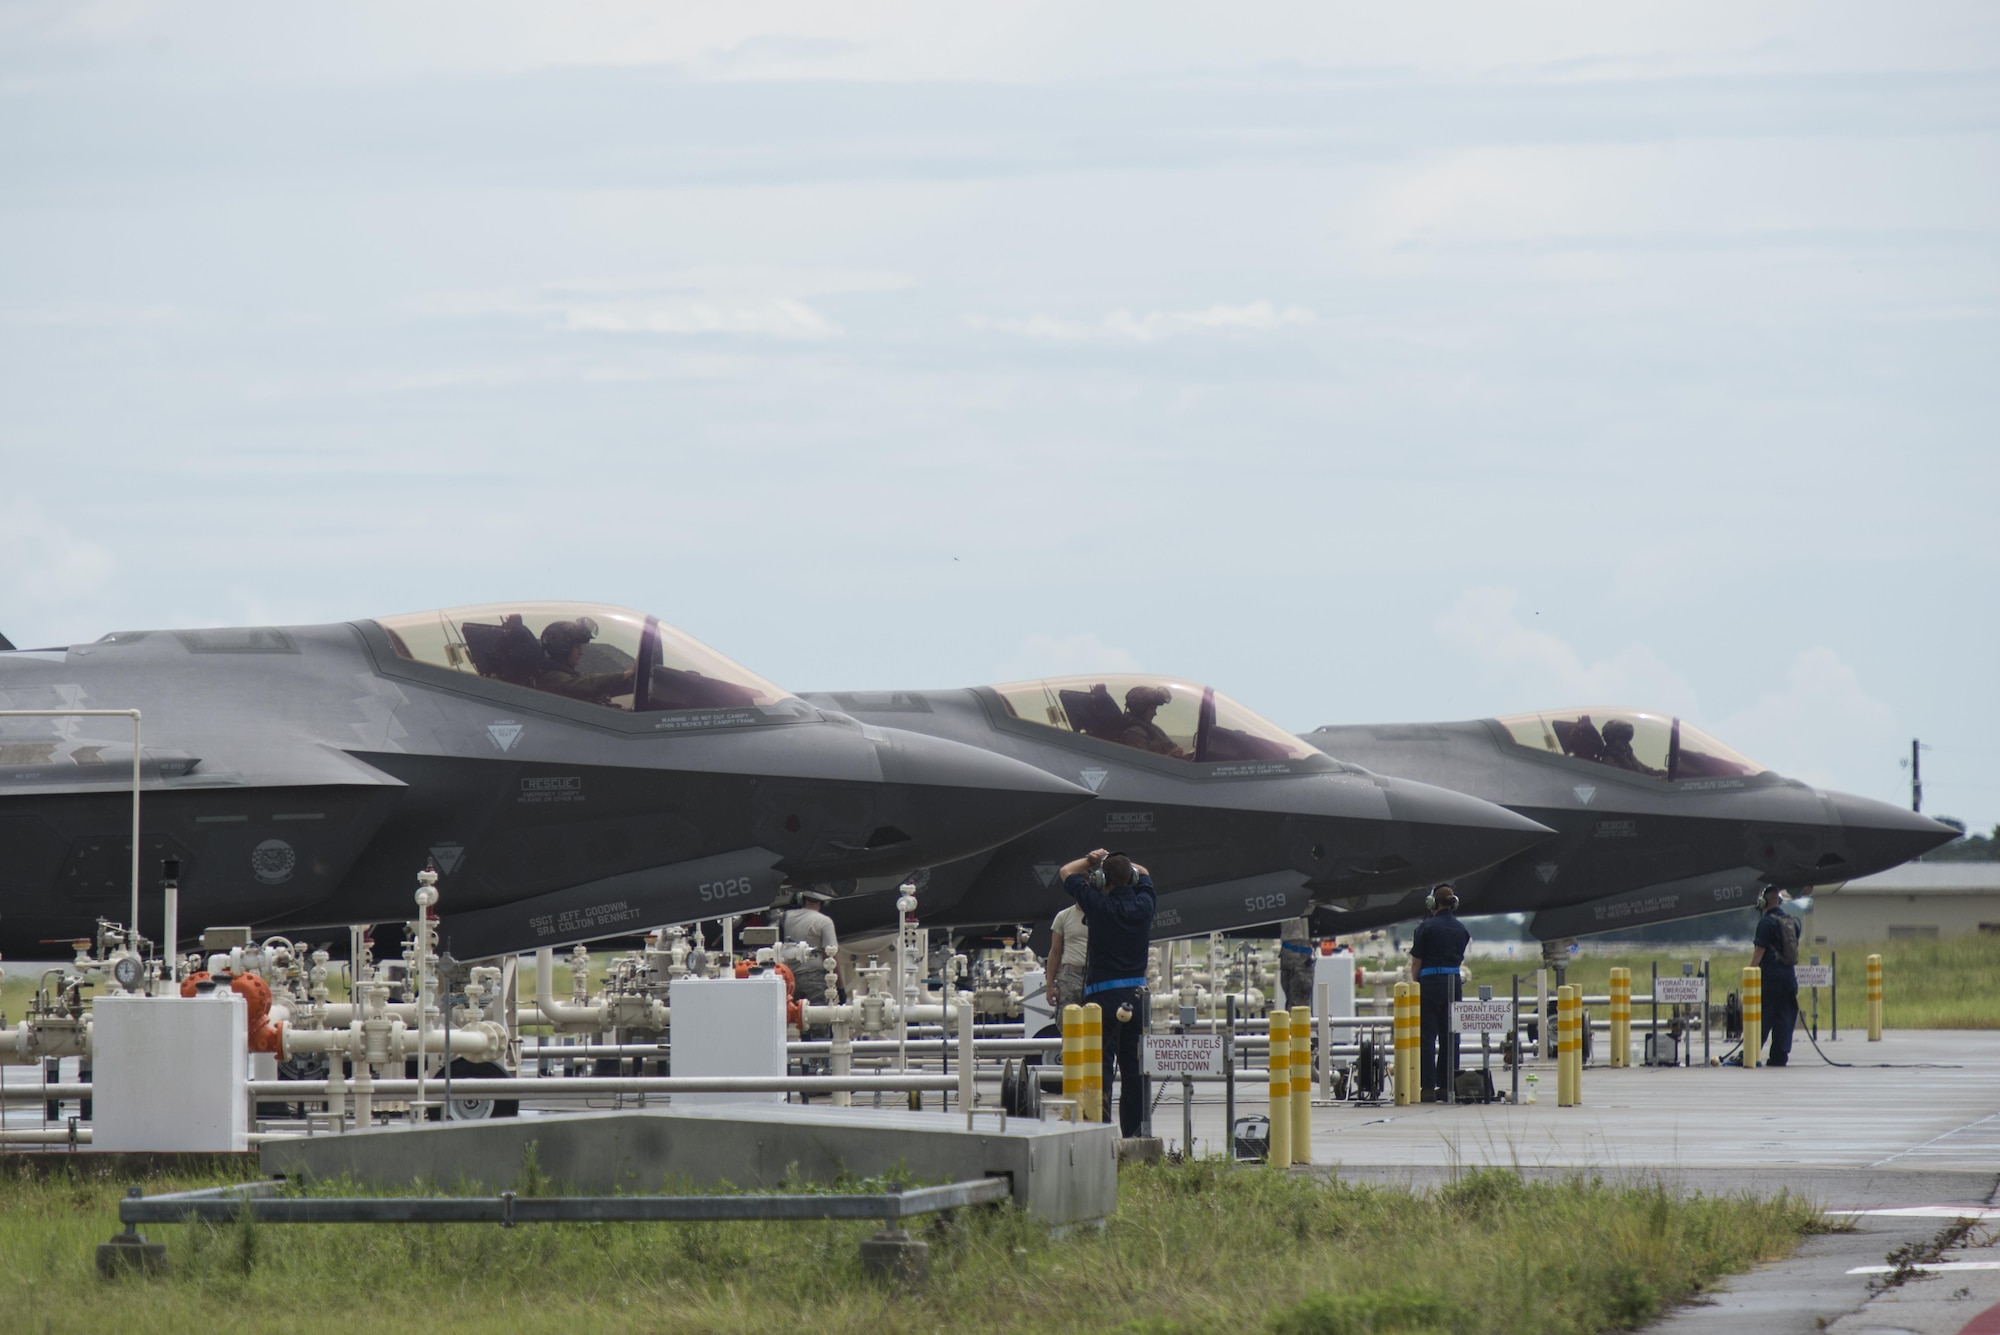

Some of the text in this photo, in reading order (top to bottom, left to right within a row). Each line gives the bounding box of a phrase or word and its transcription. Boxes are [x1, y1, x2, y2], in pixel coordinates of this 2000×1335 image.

[528, 779, 574, 789] RESCUE
[1112, 814, 1148, 823] RESCUE
[699, 877, 752, 902] 5026
[1713, 885, 1744, 901] 5013
[1244, 893, 1286, 912] 5029
[529, 901, 628, 928] SSGT JEFF GOODWIN
[536, 908, 640, 936] SRA COLTON BENNETT
[1156, 916, 1182, 928] RADER
[1657, 979, 1704, 987] HYDRANT FUELS
[1663, 986, 1699, 994] EMERGENCY
[1454, 1004, 1511, 1013] HYDRANT FUELS
[1460, 1013, 1505, 1022] EMERGENCY
[1463, 1022, 1503, 1030] SHUTDOWN
[1146, 1039, 1221, 1049] HYDRANT FUELS
[1155, 1050, 1211, 1060] EMERGENCY
[1157, 1061, 1209, 1071] SHUTDOWN
